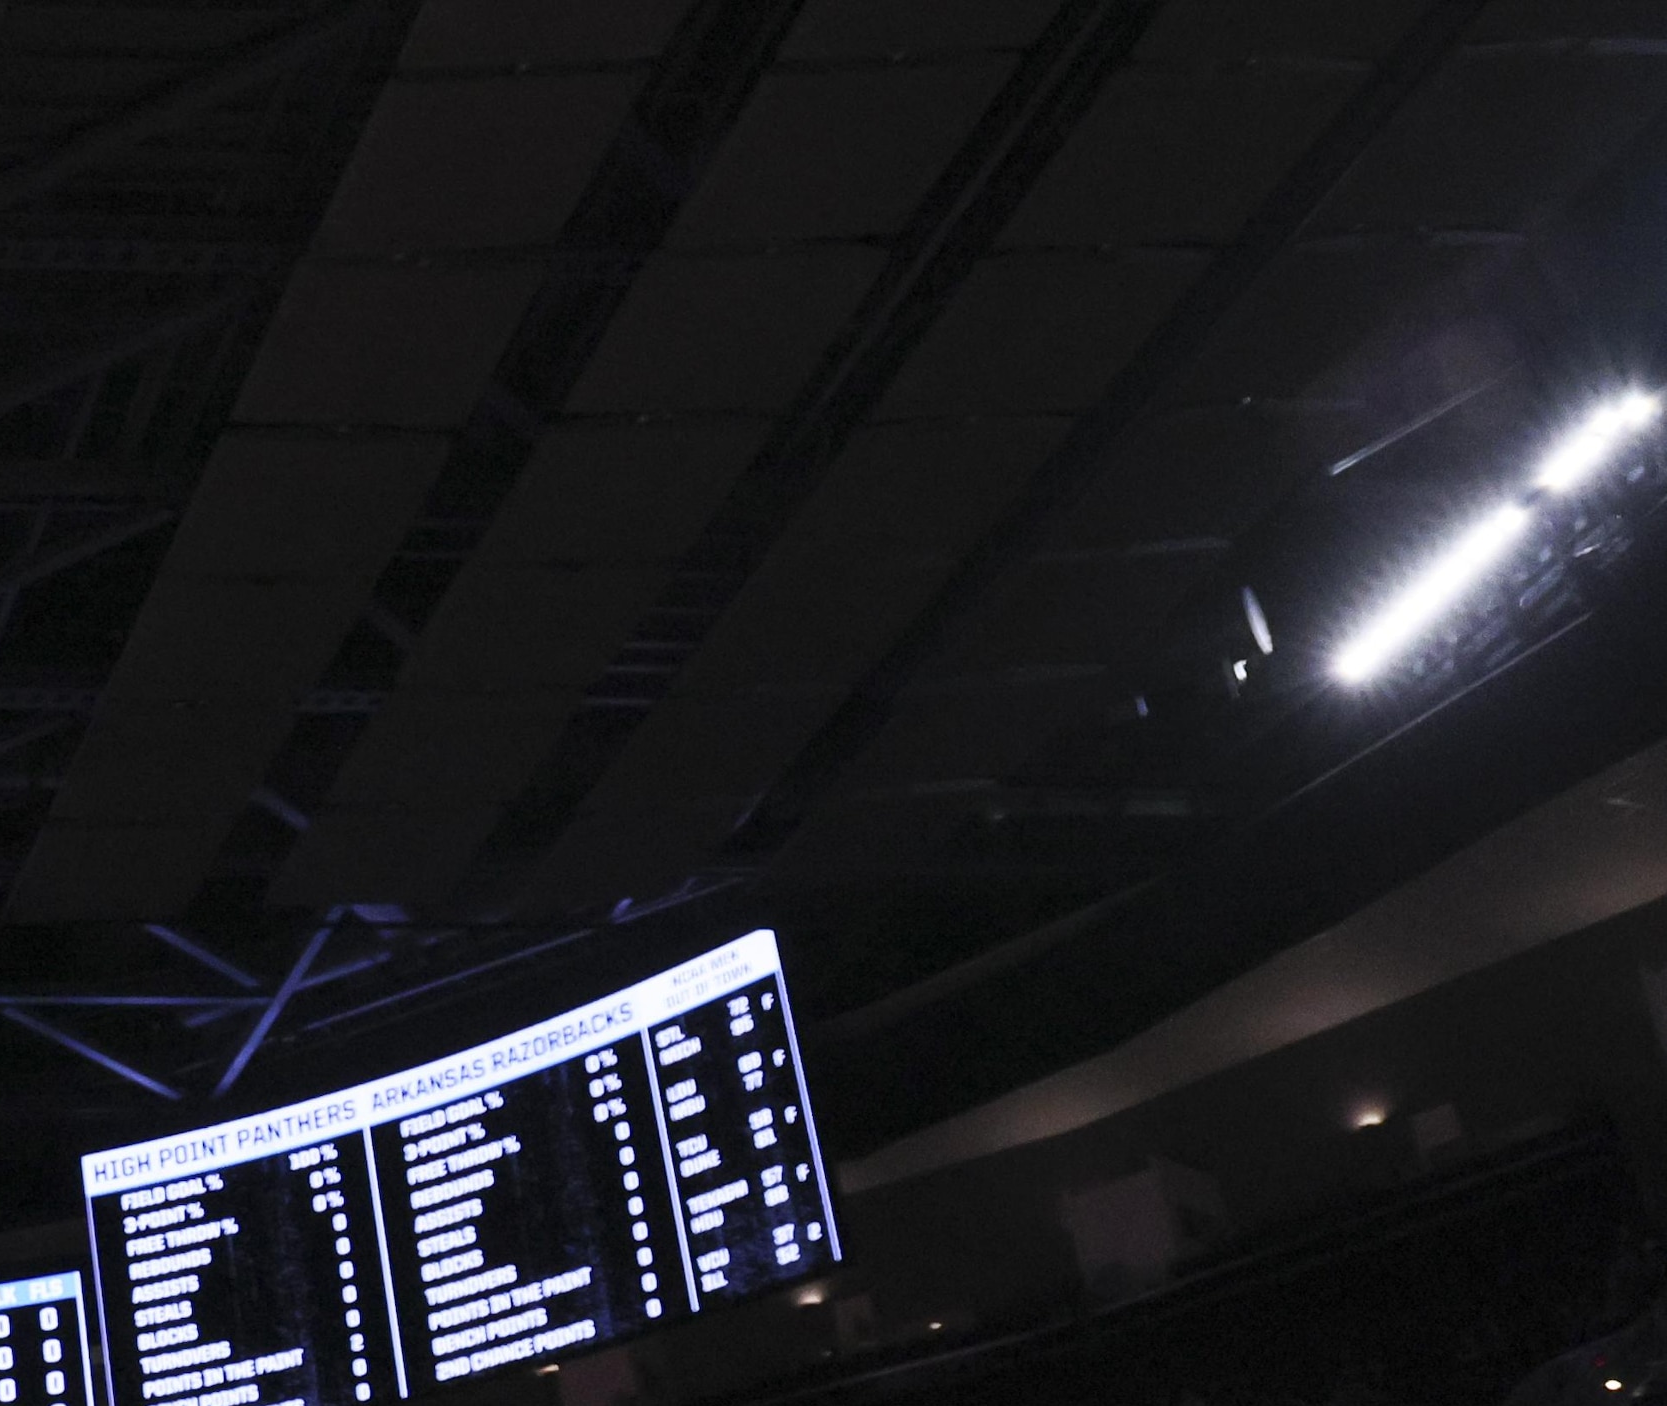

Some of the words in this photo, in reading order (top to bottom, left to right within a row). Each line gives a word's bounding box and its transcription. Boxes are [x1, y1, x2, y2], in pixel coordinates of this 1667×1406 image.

[372, 1063, 486, 1112] ARKANSAS
[491, 1002, 634, 1070] RAZORBACKS
[94, 1154, 150, 1183] HIGH
[159, 1133, 228, 1168] POINT
[237, 1100, 357, 1148] PANTHERS
[121, 1186, 165, 1211] FIELD
[165, 1177, 206, 1201] GOAL
[126, 1233, 166, 1257] FREE
[128, 1247, 212, 1281] REBOUNDS
[30, 1279, 63, 1300] FLS
[132, 1274, 199, 1304] ASSISTS
[40, 1307, 59, 1331] 0
[134, 1300, 192, 1327] STEALS
[137, 1323, 198, 1351] BLOCKS
[140, 1340, 231, 1374] TURNOVERS
[143, 1371, 203, 1399] POINTS
[203, 1366, 224, 1388] IN
[224, 1359, 255, 1384] THE
[254, 1347, 304, 1376] PAINT
